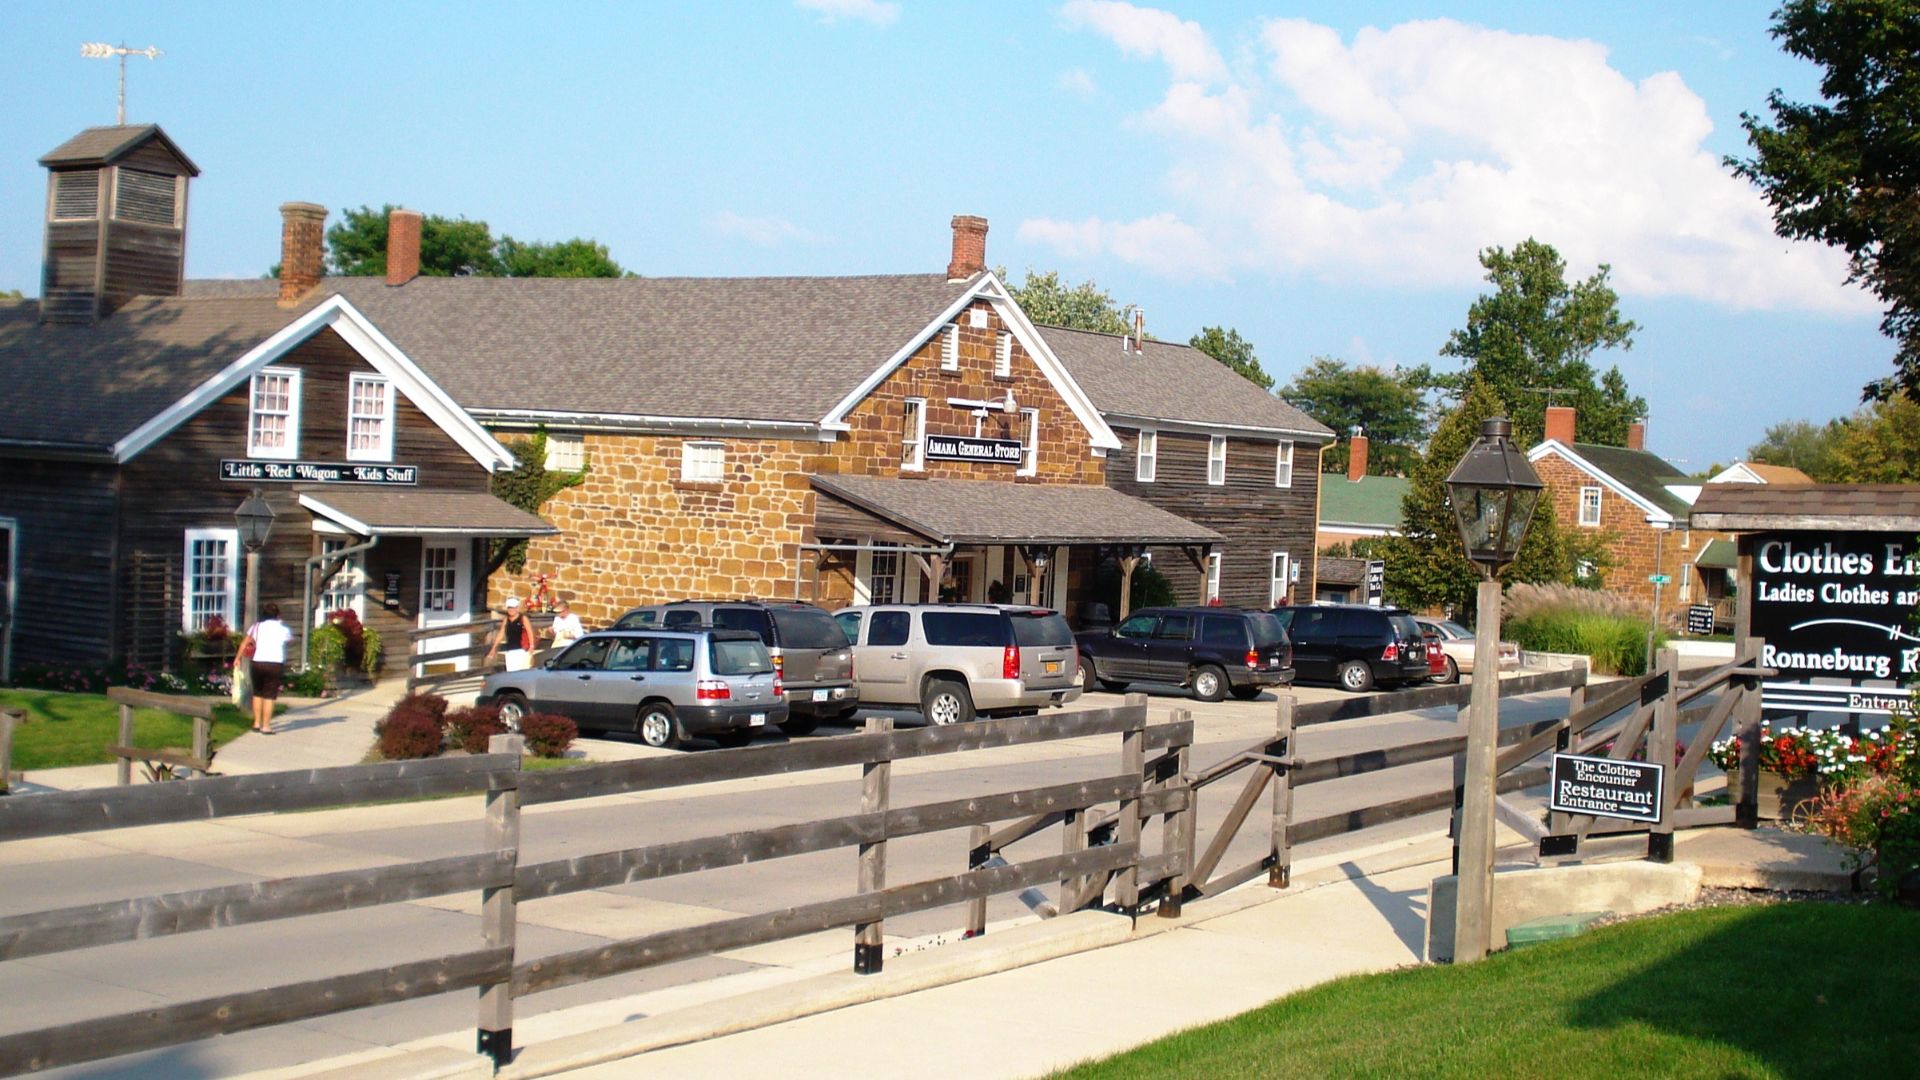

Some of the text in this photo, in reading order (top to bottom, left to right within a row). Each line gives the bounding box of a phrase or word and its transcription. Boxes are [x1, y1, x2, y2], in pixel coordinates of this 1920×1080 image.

[928, 440, 1020, 459] AMANA GENERAL STORE
[225, 463, 261, 478] Little
[265, 464, 292, 478] Red
[296, 465, 338, 482] Wagon
[354, 467, 383, 480] Kids
[386, 468, 414, 482] Stuff
[1760, 541, 1874, 575] Clothes
[1759, 581, 1815, 603] Ladies
[1821, 583, 1889, 605] Clothes
[1762, 644, 1891, 678] Ronneburg
[1573, 760, 1641, 778] The Clothes
[1577, 770, 1638, 787] Encounter
[1560, 780, 1653, 805] Restaurant
[1559, 794, 1618, 812] Entrance
